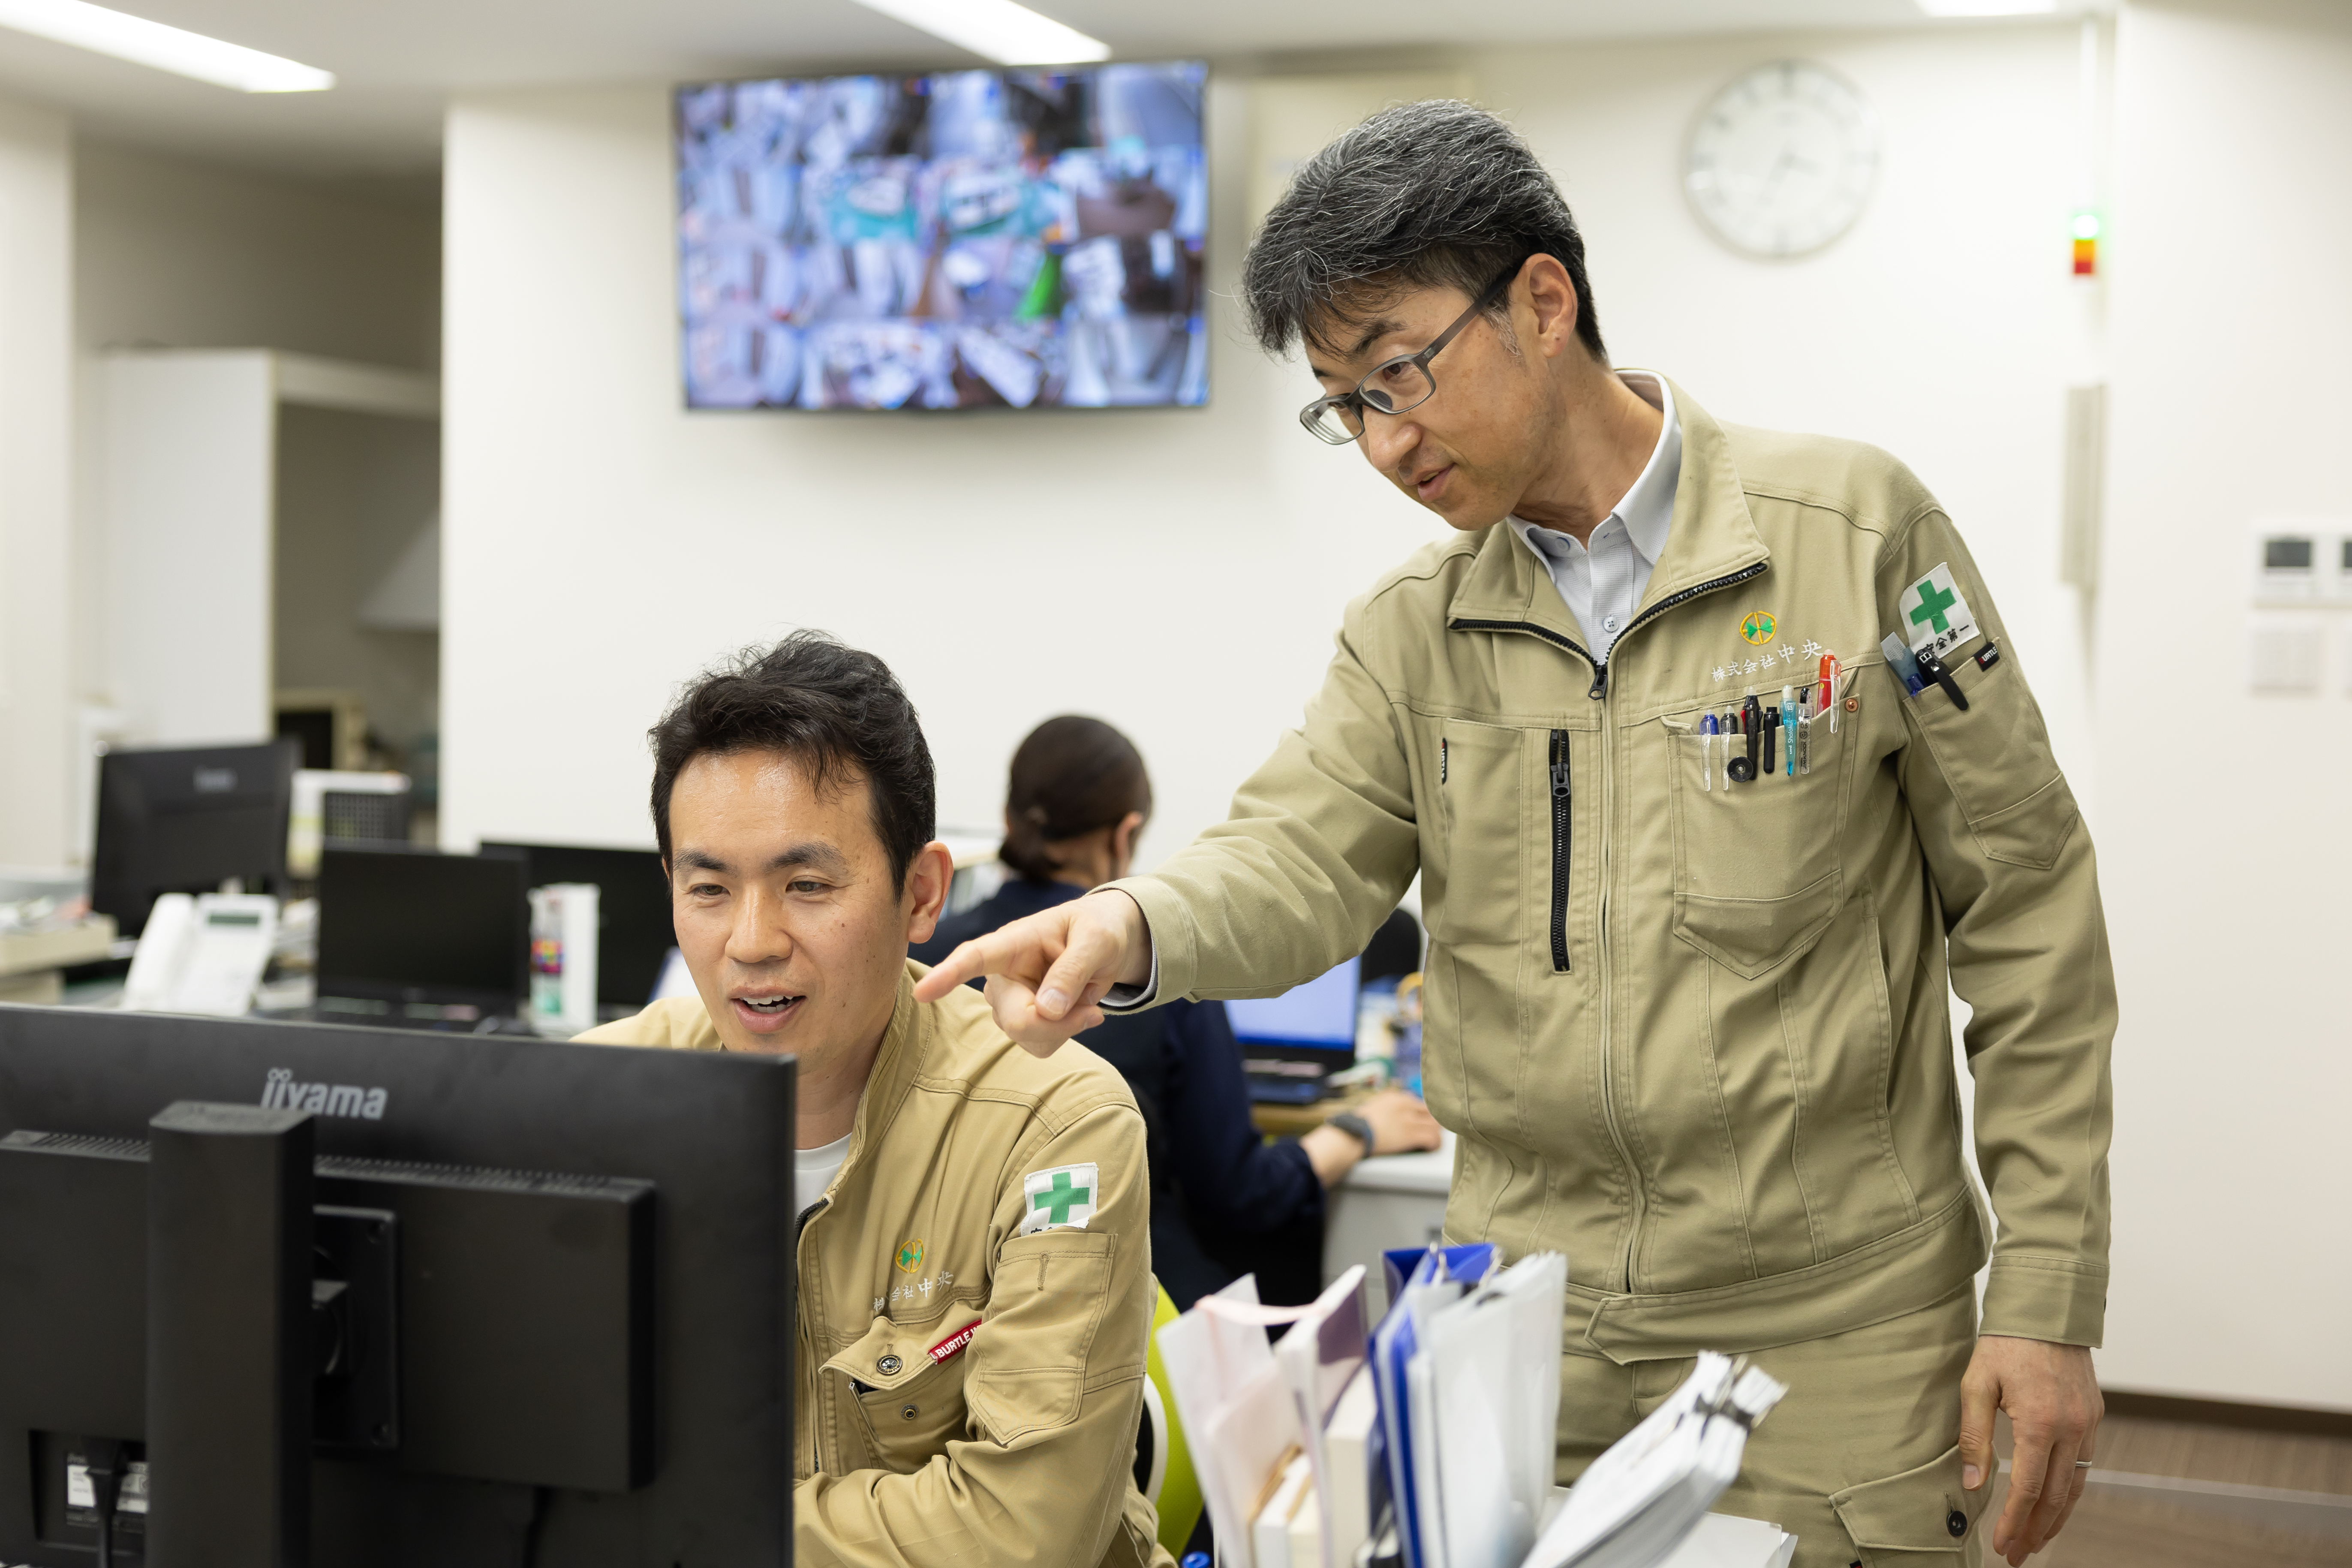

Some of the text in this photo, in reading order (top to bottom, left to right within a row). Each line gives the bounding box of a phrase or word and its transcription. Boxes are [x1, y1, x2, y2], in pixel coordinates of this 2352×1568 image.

[1979, 646, 1997, 664] BURTLE
[260, 1067, 388, 1120] iiyama
[873, 1270, 954, 1312] 株会社中央
[935, 1331, 971, 1358] BURTLE
